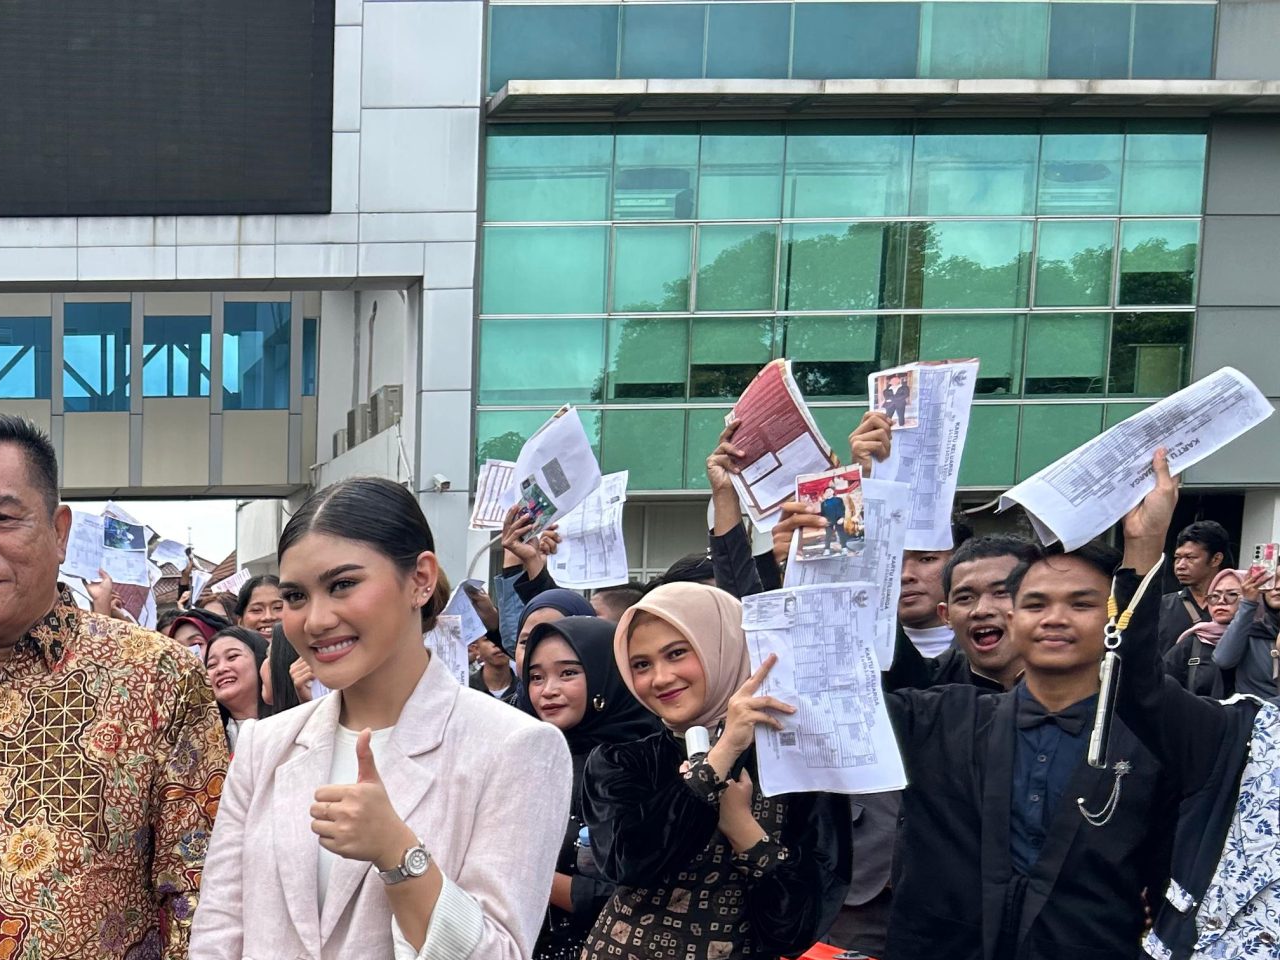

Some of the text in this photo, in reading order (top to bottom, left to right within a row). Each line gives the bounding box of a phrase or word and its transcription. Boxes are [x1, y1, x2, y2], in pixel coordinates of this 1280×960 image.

[952, 422, 960, 443] KARTU
[1170, 438, 1201, 459] KARTU
[865, 647, 874, 669] KARTU
